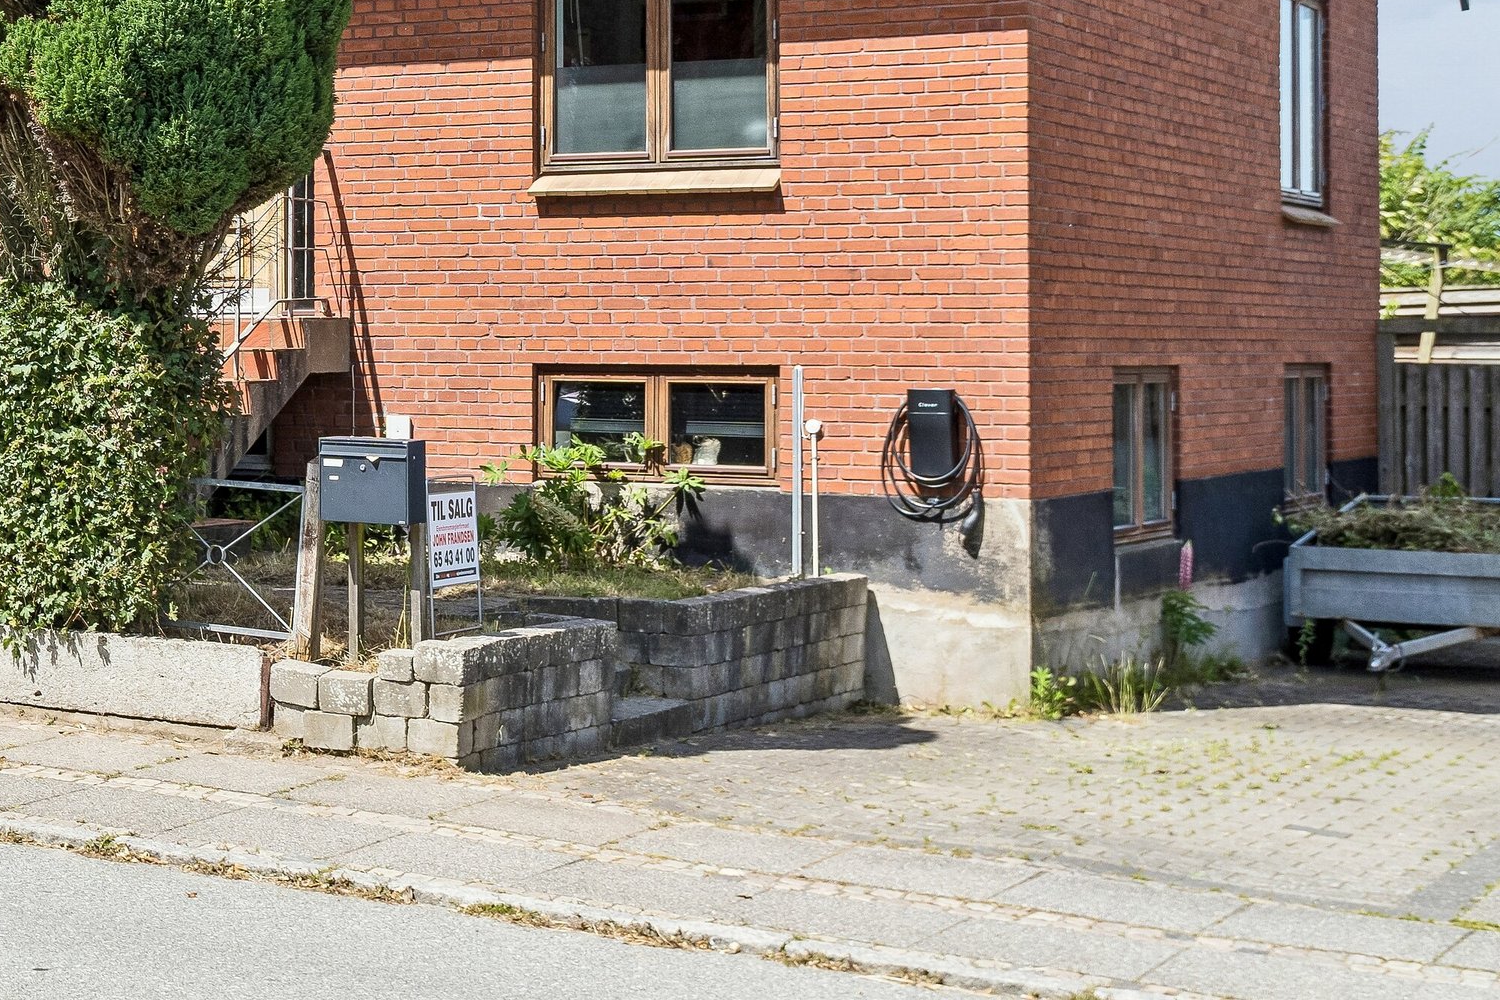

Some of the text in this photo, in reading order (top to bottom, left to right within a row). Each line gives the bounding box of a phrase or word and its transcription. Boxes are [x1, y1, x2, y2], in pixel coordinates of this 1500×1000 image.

[430, 498, 473, 521] TIL SALG
[433, 533, 446, 546] JOHN
[433, 547, 475, 567] 65 43 41 00
